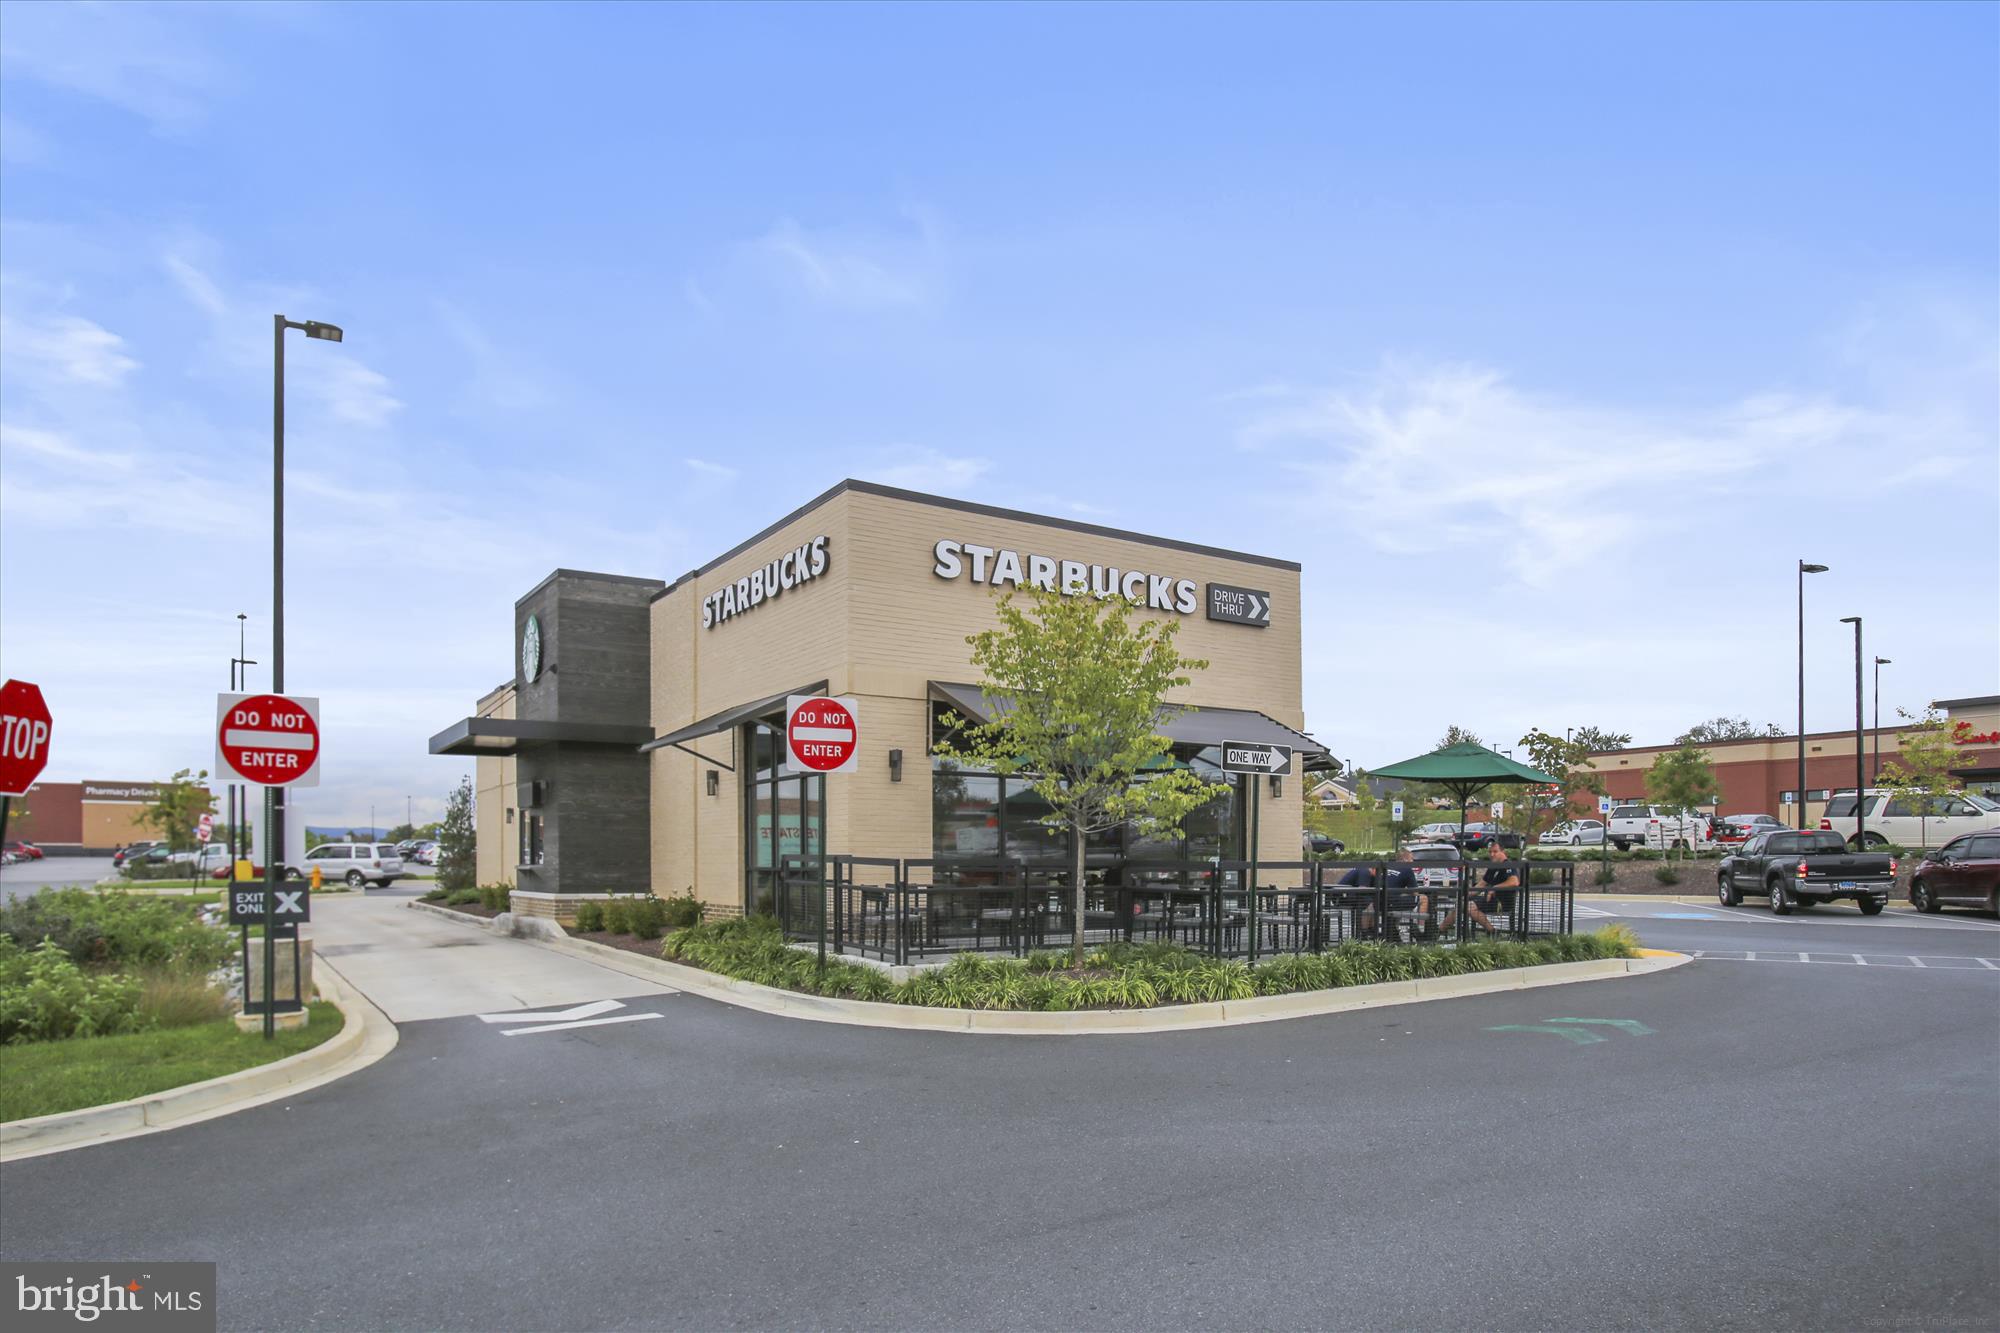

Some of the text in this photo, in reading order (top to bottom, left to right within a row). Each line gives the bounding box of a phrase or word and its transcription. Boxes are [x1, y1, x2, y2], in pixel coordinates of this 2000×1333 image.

[703, 535, 829, 629] STARBUCKS
[934, 539, 1198, 614] STARBUCKS
[1214, 589, 1245, 605] DRIVE
[1214, 601, 1243, 616] THRU
[234, 710, 306, 729] DO NOT
[798, 711, 847, 725] DO NOT
[0, 715, 48, 760] TOP
[803, 744, 842, 757] ENTER
[1229, 750, 1272, 765] ONE WAY
[240, 751, 299, 769] ENTER
[85, 786, 130, 798] Pharmacy
[235, 892, 265, 904] EXIT
[235, 903, 266, 915] ONL
